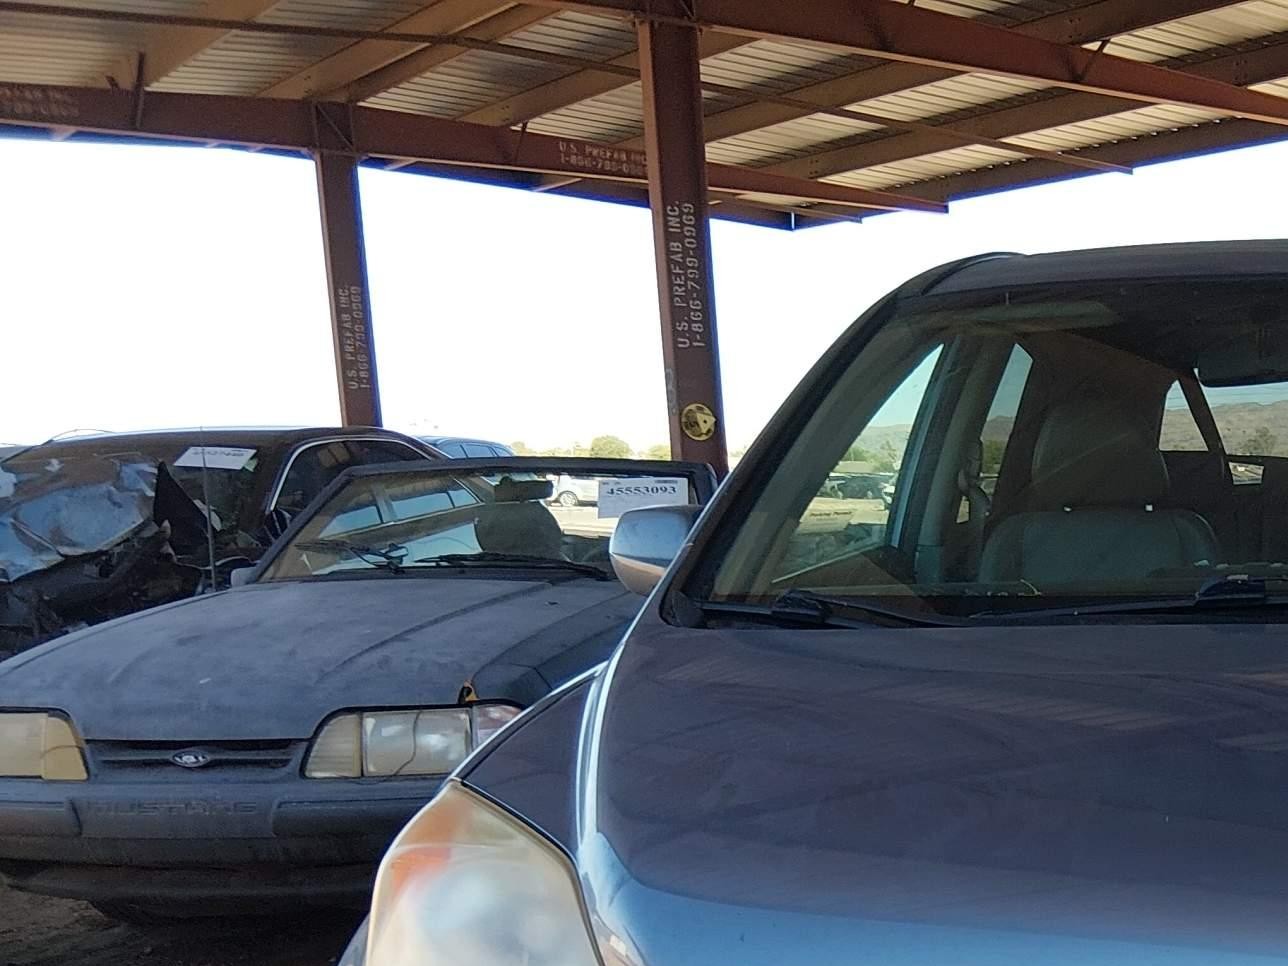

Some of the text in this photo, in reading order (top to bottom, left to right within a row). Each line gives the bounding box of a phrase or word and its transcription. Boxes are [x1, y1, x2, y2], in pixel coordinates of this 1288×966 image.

[666, 200, 690, 348] U.S. PREFAB INC.
[682, 203, 705, 347] 1-866-799-0969
[341, 313, 356, 361] PREFAB
[606, 485, 677, 497] 45553093
